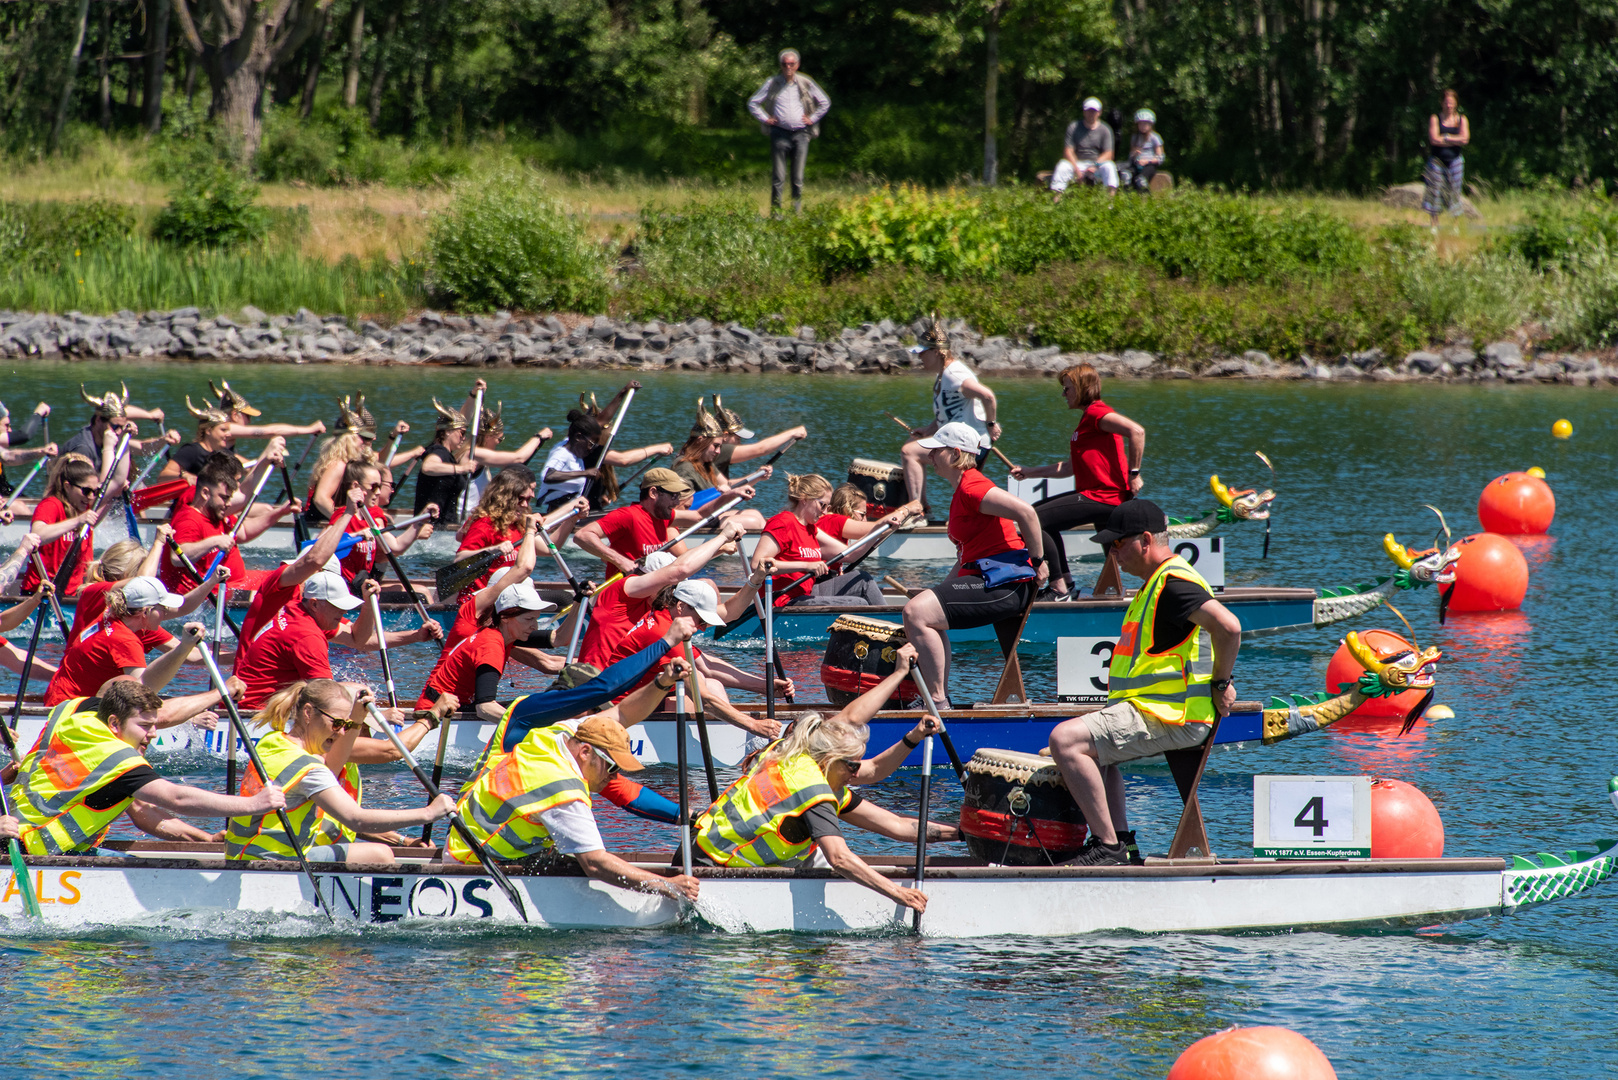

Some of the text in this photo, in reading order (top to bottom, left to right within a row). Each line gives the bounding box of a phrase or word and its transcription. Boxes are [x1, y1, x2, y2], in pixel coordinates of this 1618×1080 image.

[1033, 478, 1048, 500] 1
[1090, 641, 1117, 691] 3
[1294, 796, 1329, 836] 4
[1306, 849, 1361, 858] Essen-Kupferdreh
[312, 875, 494, 923] INEOS
